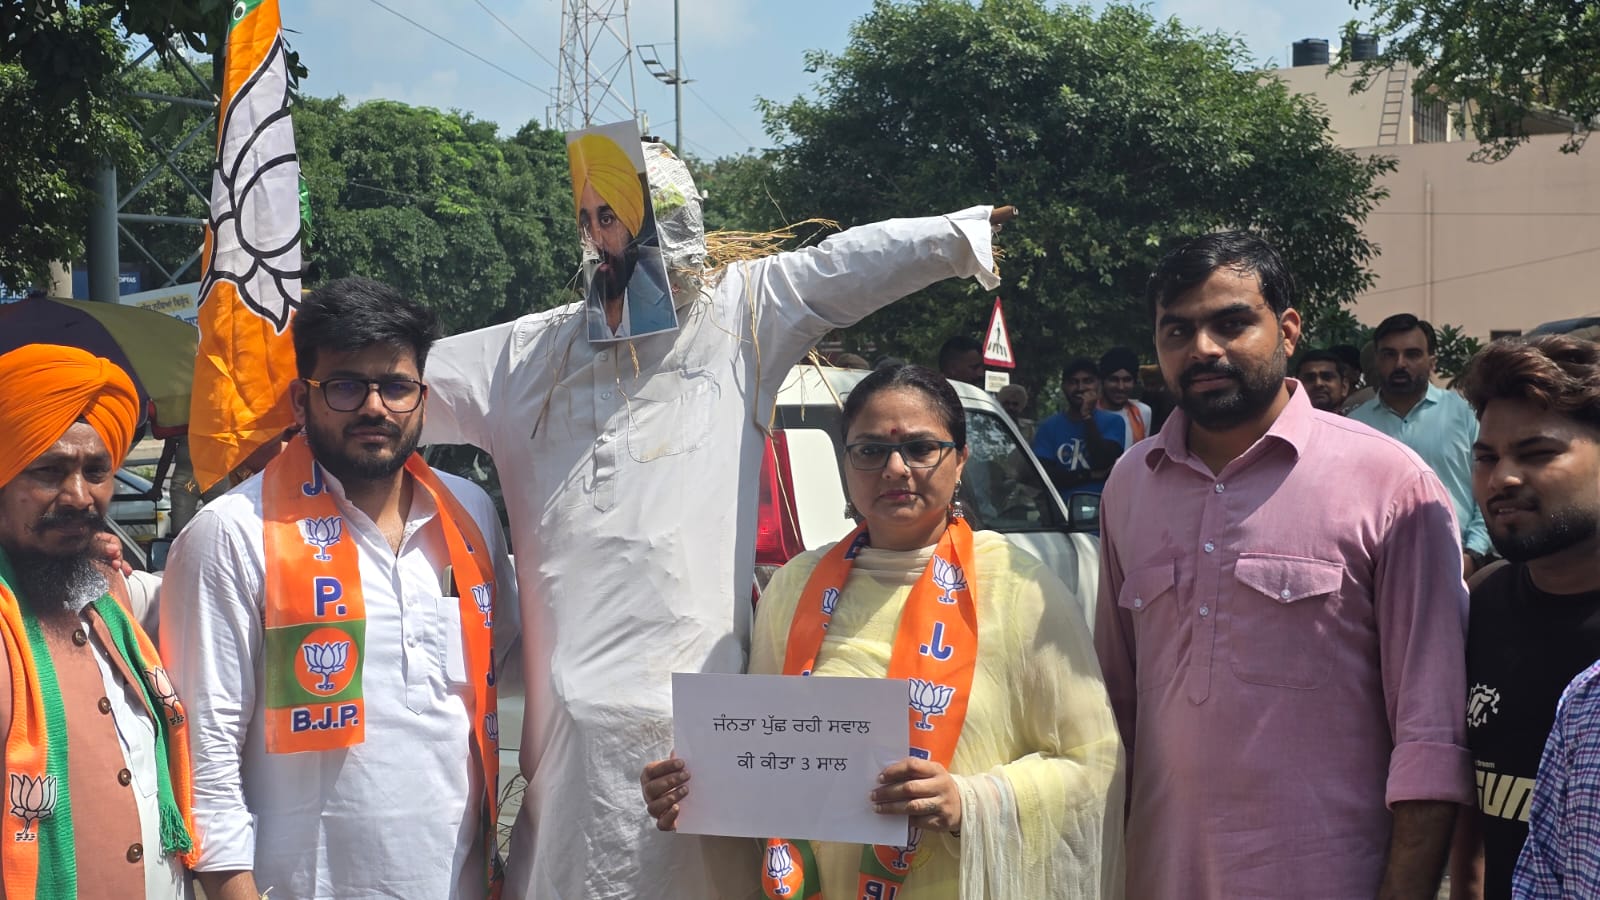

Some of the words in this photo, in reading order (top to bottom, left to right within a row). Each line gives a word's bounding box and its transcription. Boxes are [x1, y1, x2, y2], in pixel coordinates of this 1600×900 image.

[314, 577, 347, 617] P.
[292, 704, 359, 733] B.J.P.
[712, 713, 757, 732] ਜੰਨਤਾ
[762, 714, 788, 736] ਪੁੱਛ
[791, 715, 823, 733] ਰਹੀ
[826, 719, 872, 734] ਸਵਾਲ
[736, 751, 756, 770] ਕੀ
[759, 751, 797, 771] ਕੀਤਾ
[801, 757, 810, 771] 3
[815, 757, 849, 772] ਸਾਲ
